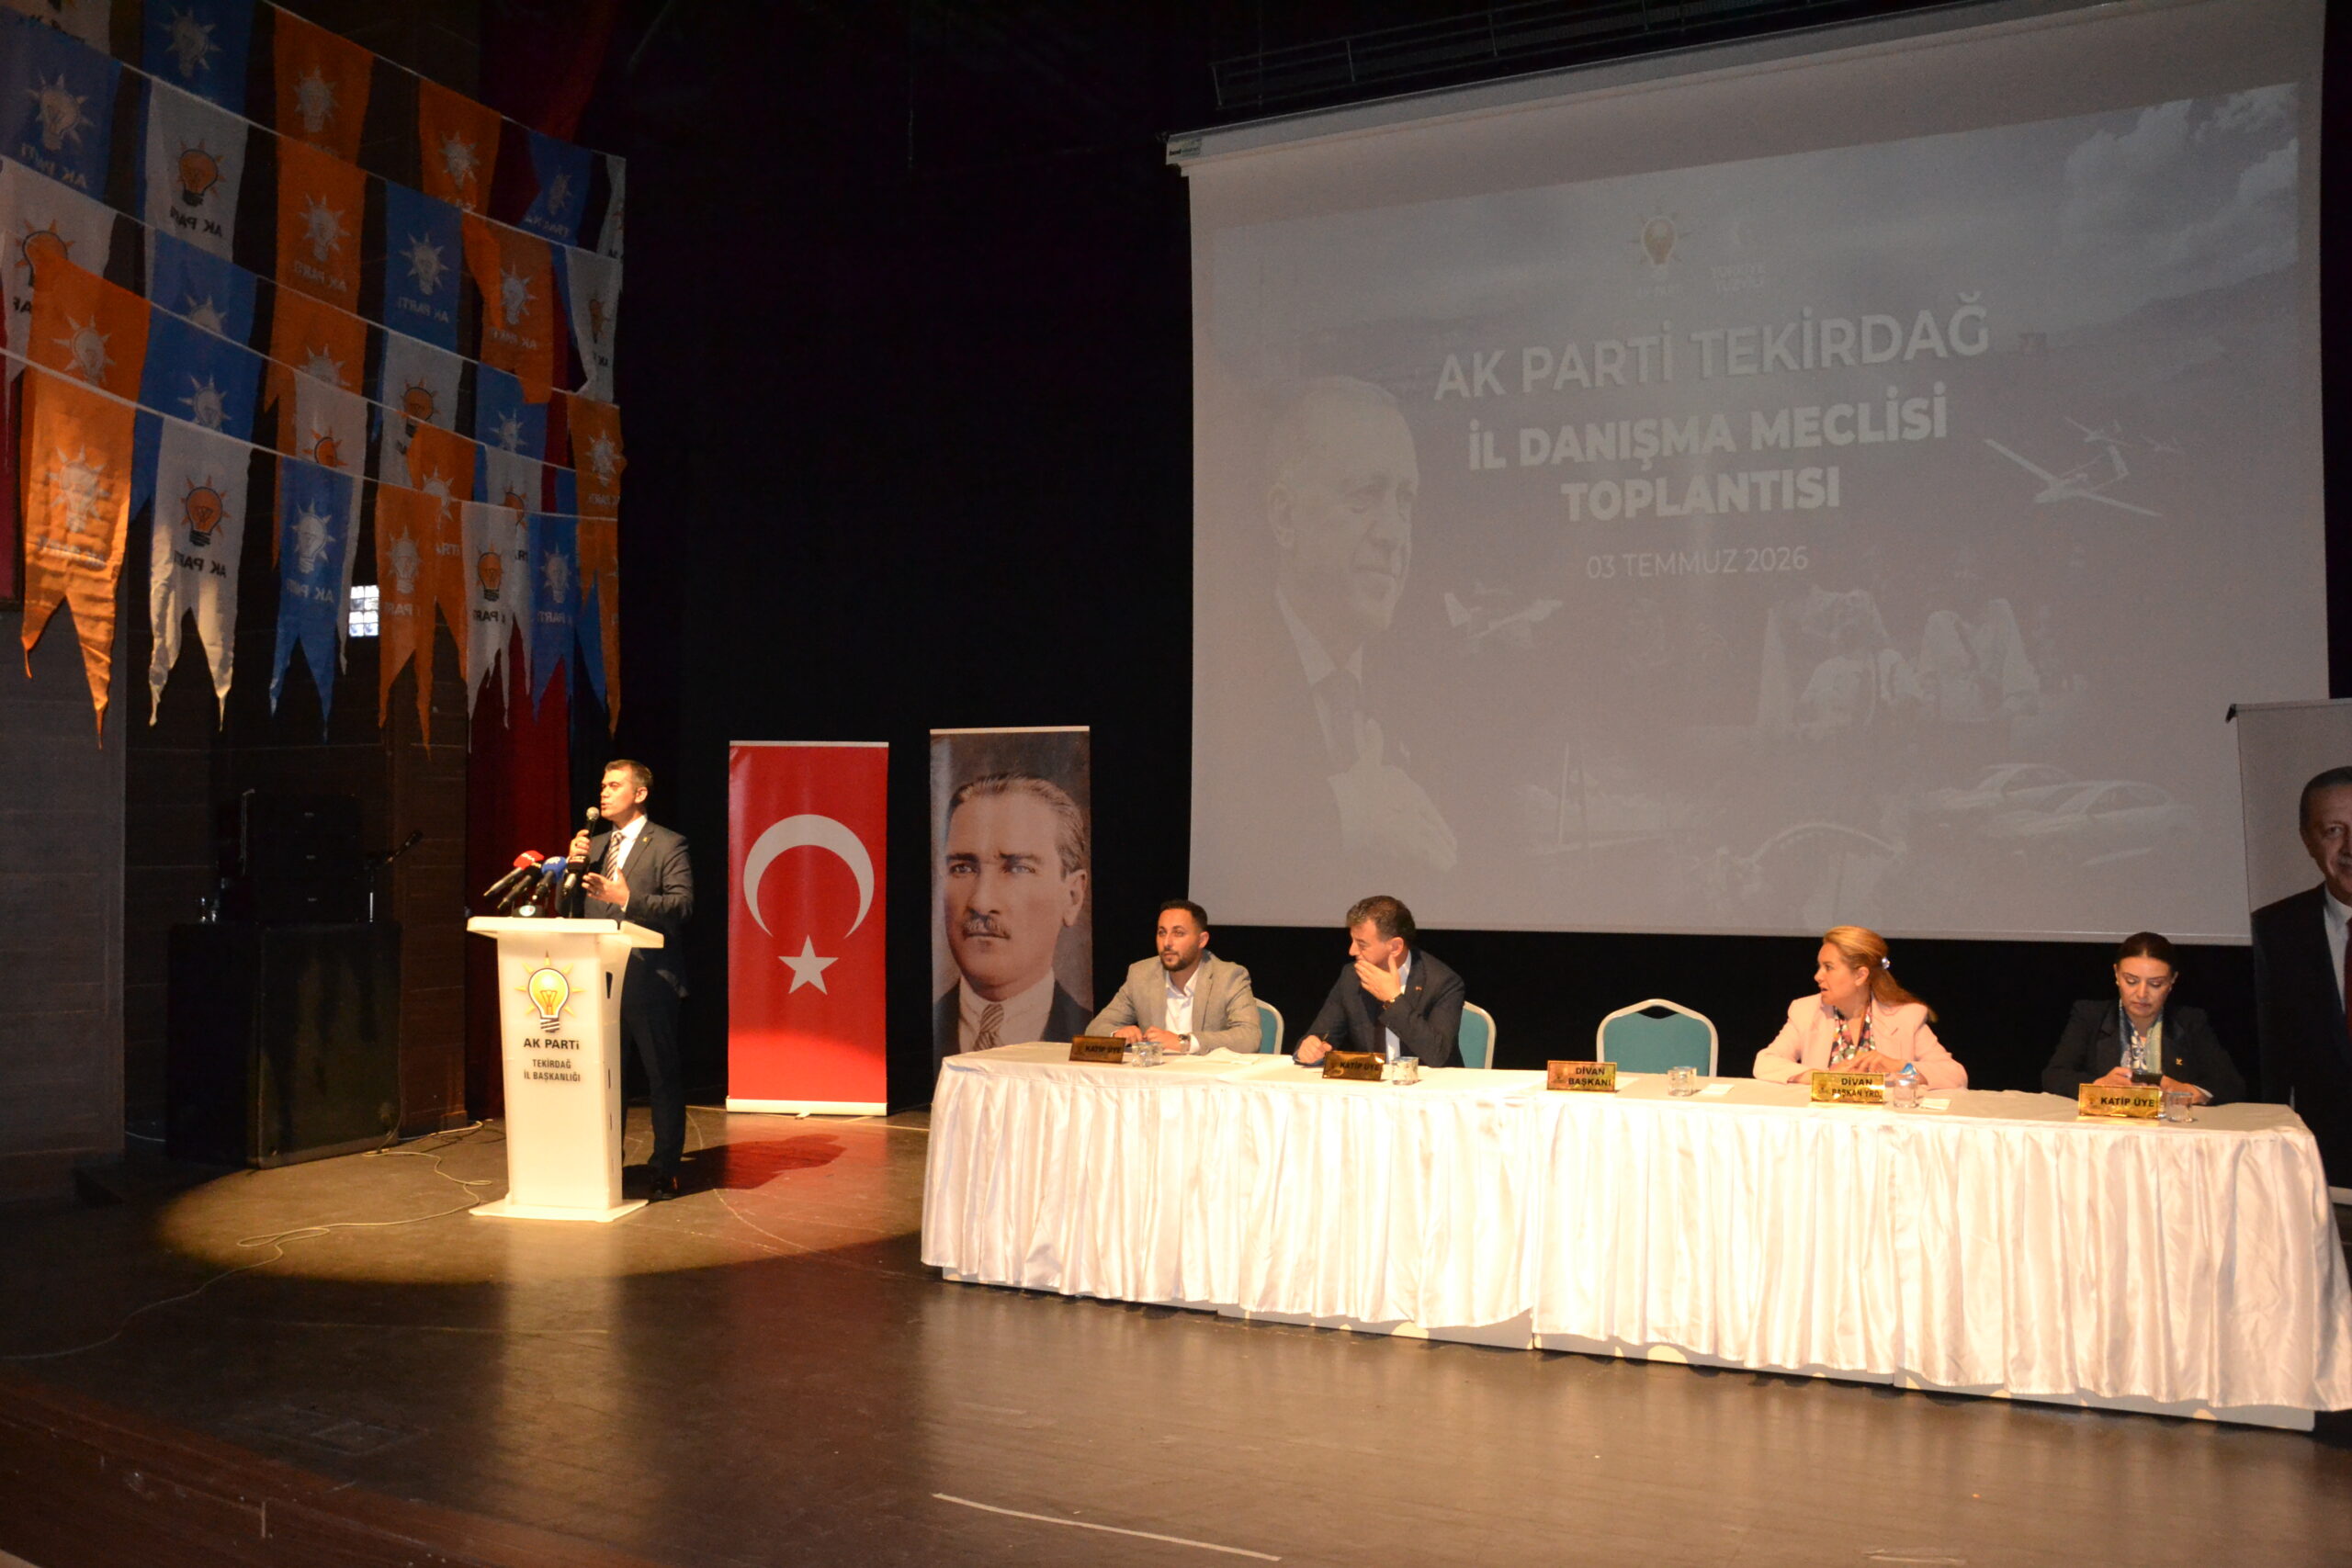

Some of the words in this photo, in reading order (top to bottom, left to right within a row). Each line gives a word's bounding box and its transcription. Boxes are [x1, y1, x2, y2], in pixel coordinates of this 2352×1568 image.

[1433, 350, 1507, 401] AK
[1521, 319, 1674, 394] PARTİ
[1689, 290, 1990, 379] TEKİRDAĞ
[1468, 418, 1508, 471] İL
[1519, 412, 1736, 471] DANIŞMA
[1749, 380, 1948, 452] MECLİSİ
[1559, 466, 1841, 523] TOPLANTISI
[1585, 555, 1617, 580] 03
[1621, 548, 1740, 579] TEMMUZ
[1744, 546, 1809, 572] 2026
[524, 1038, 540, 1048] AK
[532, 1058, 571, 1069] TEKİRDAĞ
[1340, 1060, 1363, 1070] KATİP
[524, 1069, 530, 1079] İL
[533, 1071, 581, 1083] BAŞKANLIĞI
[1576, 1066, 1605, 1076] DİVAN
[1568, 1077, 1611, 1087] BAŞKANI
[1841, 1077, 1873, 1086] DİVAN
[2100, 1097, 2131, 1107] KATİP
[2133, 1097, 2154, 1108] ÜYE
